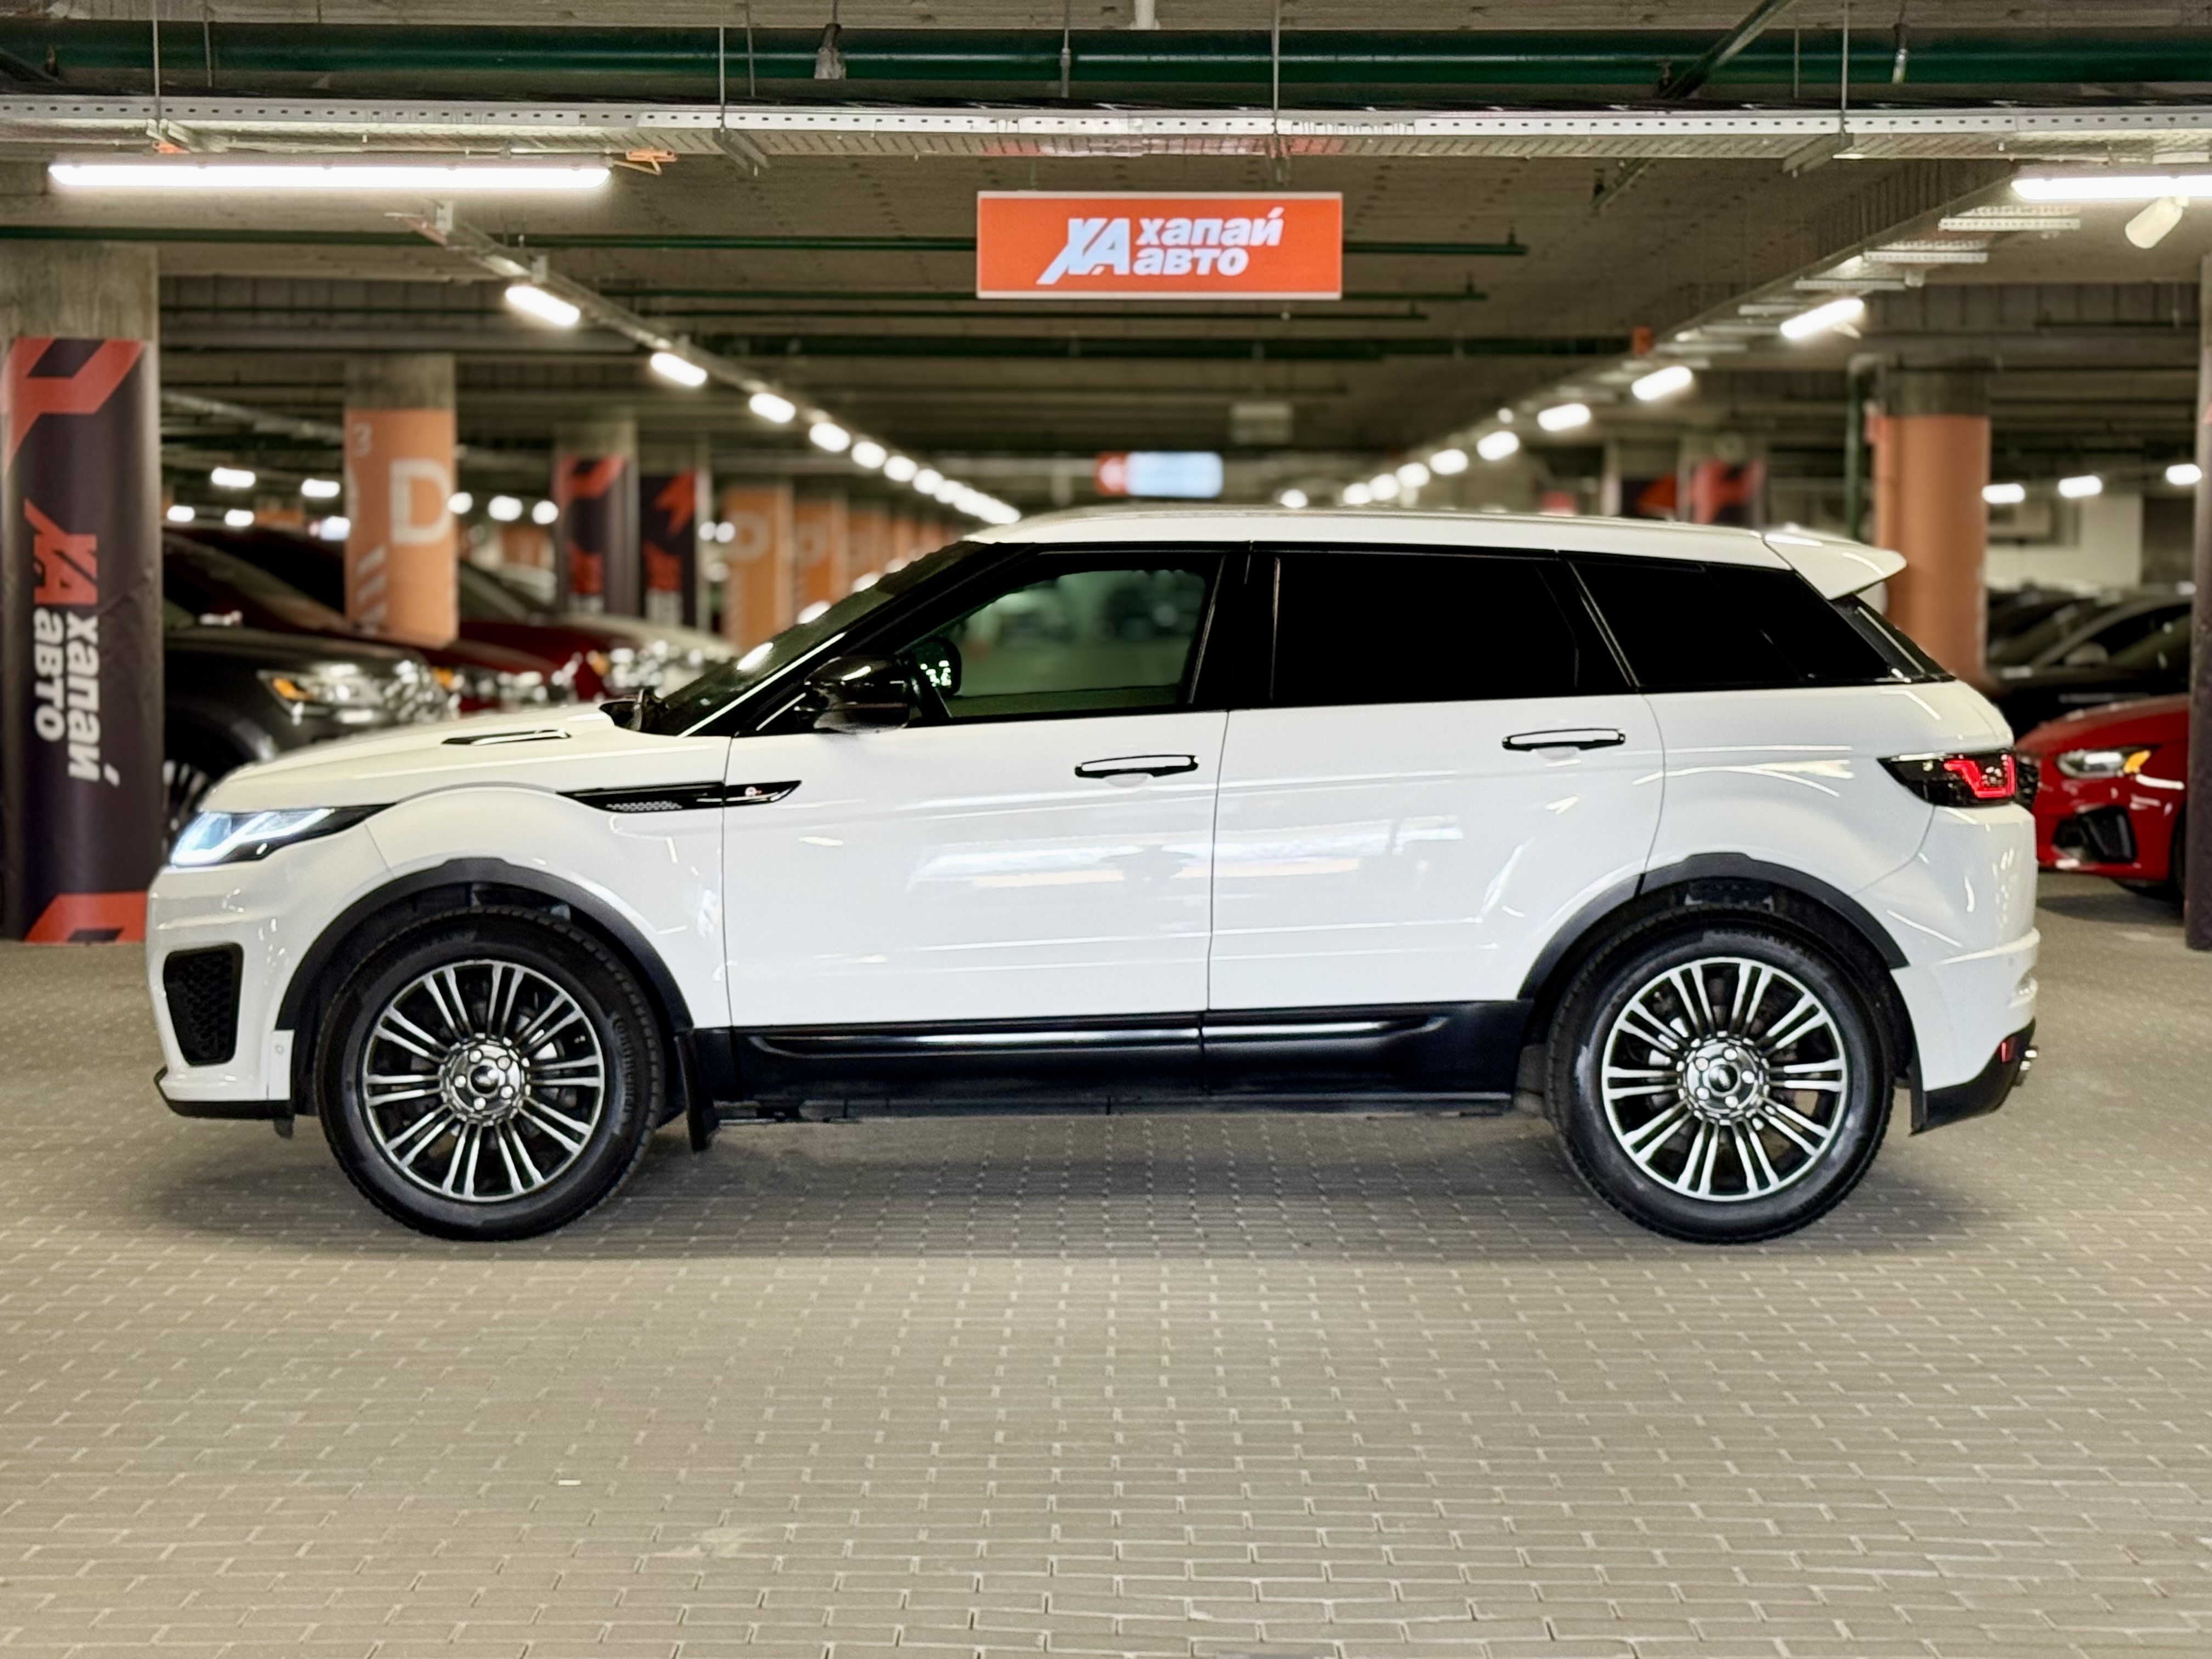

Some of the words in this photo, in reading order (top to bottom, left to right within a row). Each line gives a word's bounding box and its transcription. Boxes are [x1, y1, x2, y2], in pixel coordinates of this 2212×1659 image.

[1135, 207, 1284, 246] хапай
[1132, 247, 1249, 276] авто
[352, 422, 373, 458] 3
[389, 459, 454, 545] D
[33, 607, 65, 742] авто
[66, 611, 120, 787] хапай
